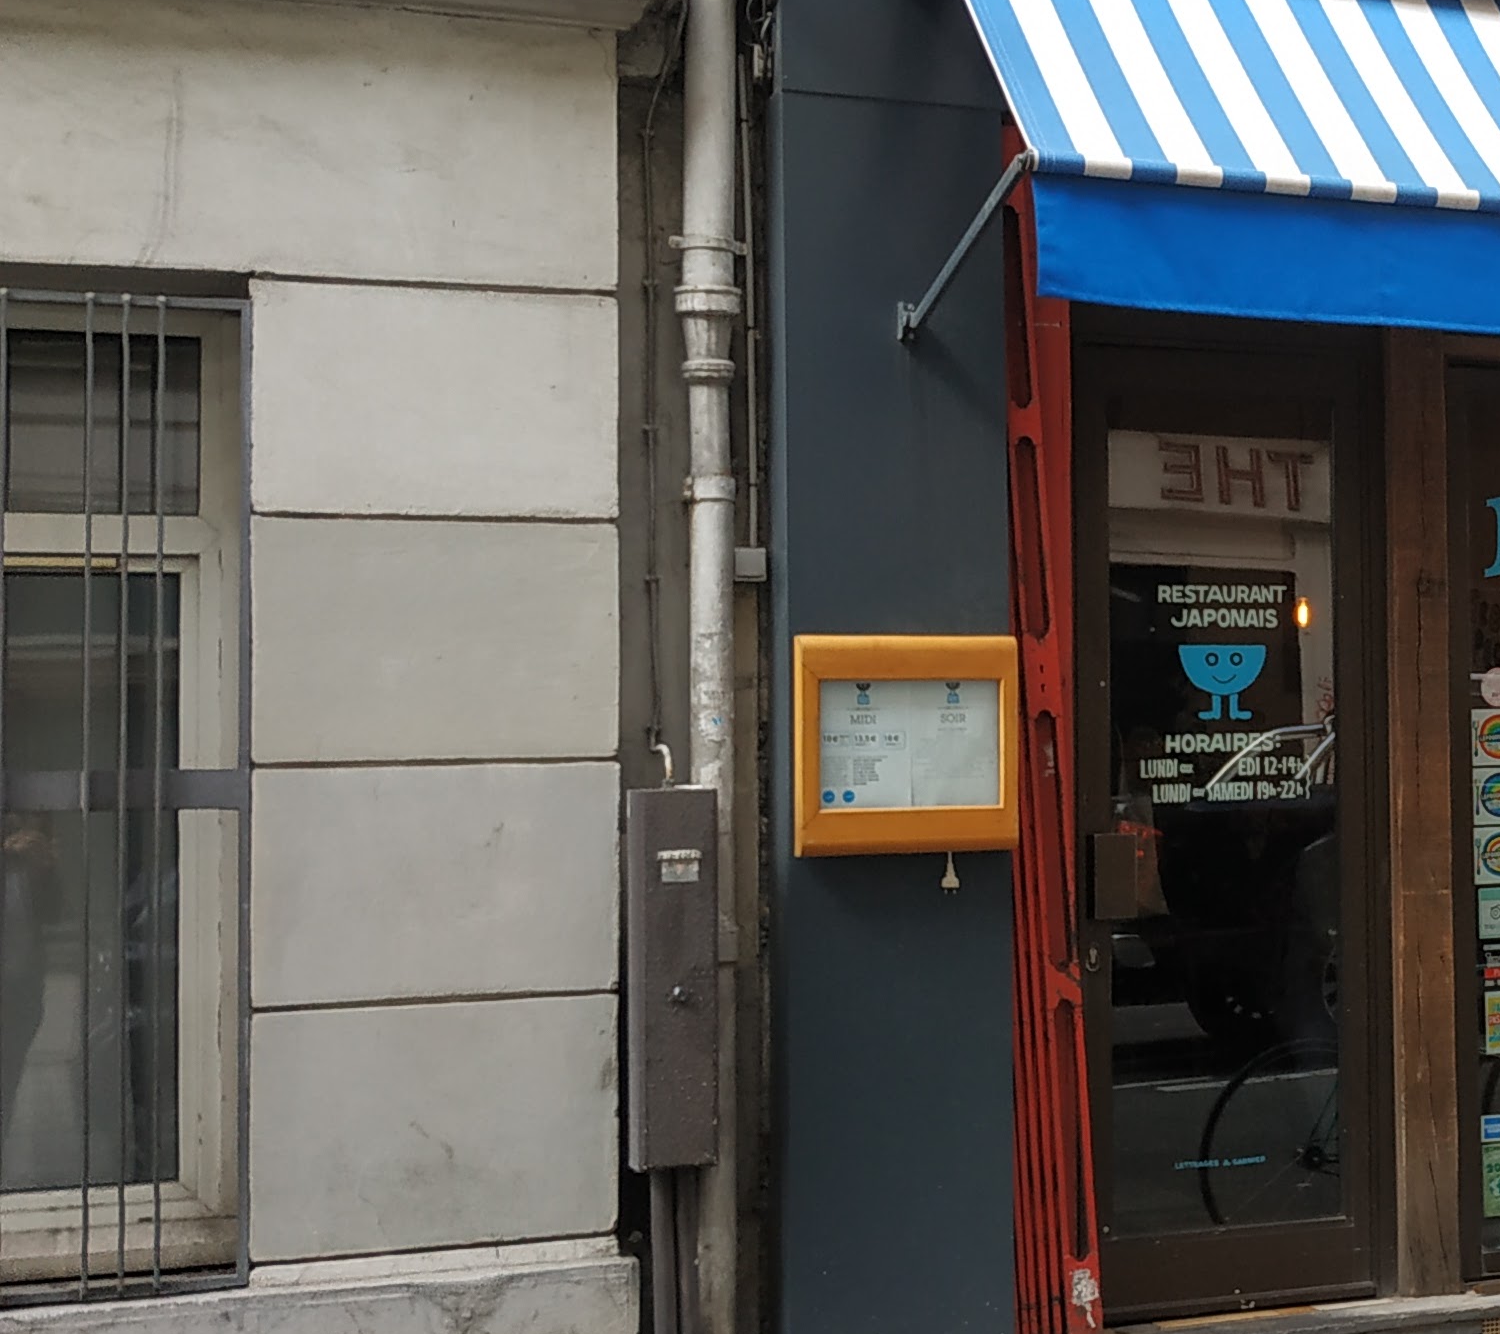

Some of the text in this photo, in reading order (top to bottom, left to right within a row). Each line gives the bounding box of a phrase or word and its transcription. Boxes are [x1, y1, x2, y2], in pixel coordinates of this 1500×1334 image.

[1157, 584, 1288, 604] RESTAURANT
[1170, 608, 1279, 629] JAPONAIS
[850, 714, 877, 725] MIDI
[940, 713, 967, 724] SOIR
[1165, 732, 1283, 754] HORAIRES:
[1139, 758, 1178, 779] LUNDI
[1152, 782, 1191, 804] LUNDI
[1207, 780, 1254, 802] SAMEDI
[1256, 780, 1304, 800] 19h-22h
